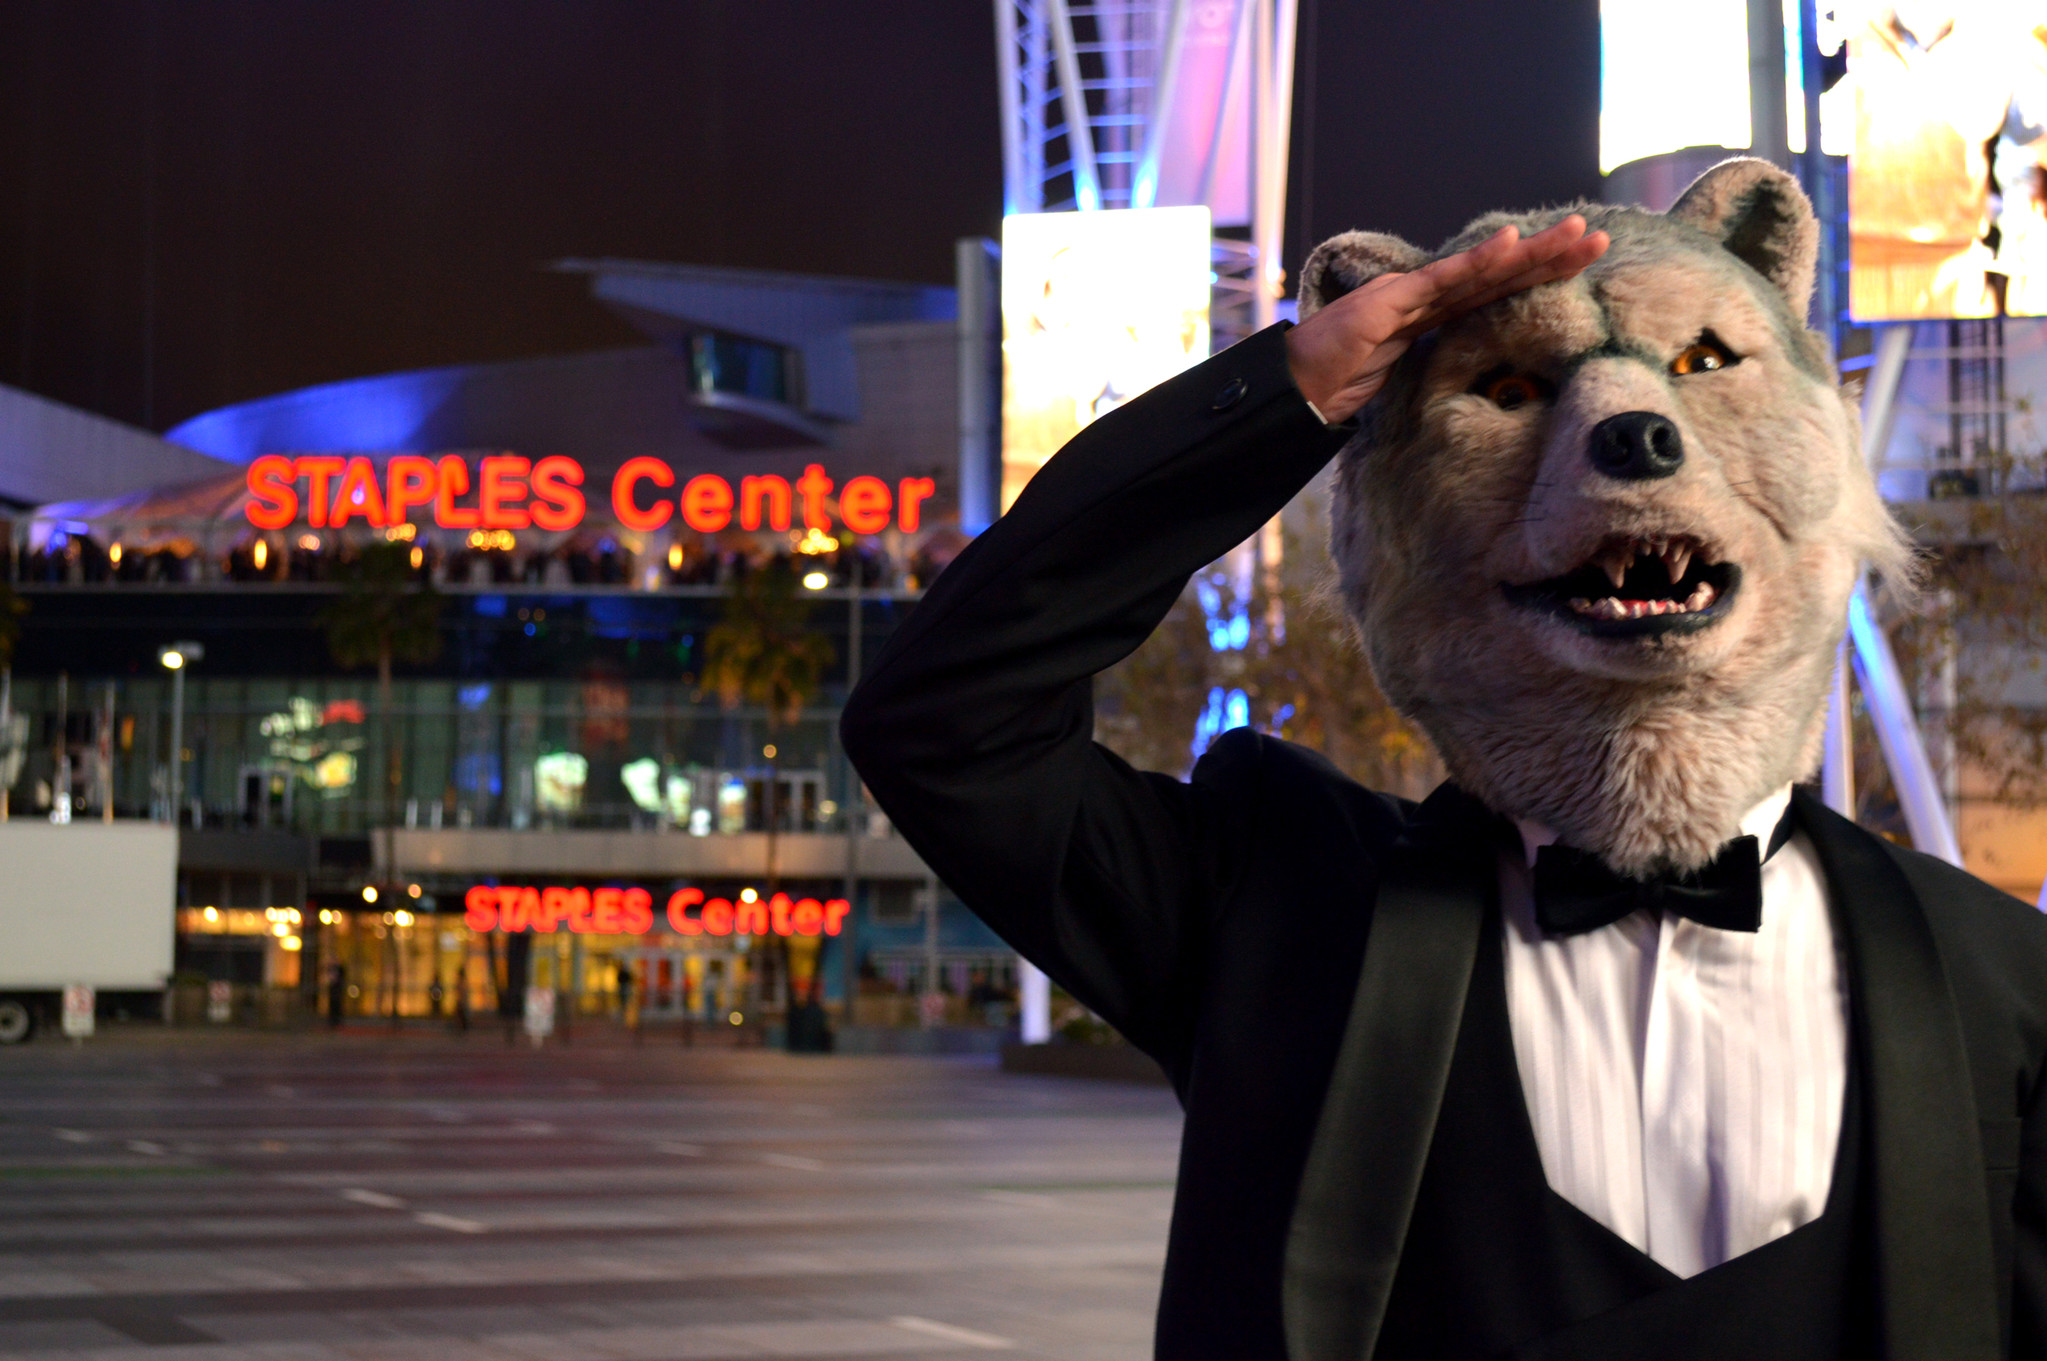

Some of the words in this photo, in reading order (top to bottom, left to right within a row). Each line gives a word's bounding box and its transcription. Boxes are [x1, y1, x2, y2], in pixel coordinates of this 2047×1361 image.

[245, 455, 585, 531] STAPLES
[612, 456, 934, 534] Center
[465, 885, 653, 934] STAPLES
[667, 888, 850, 936] Center
